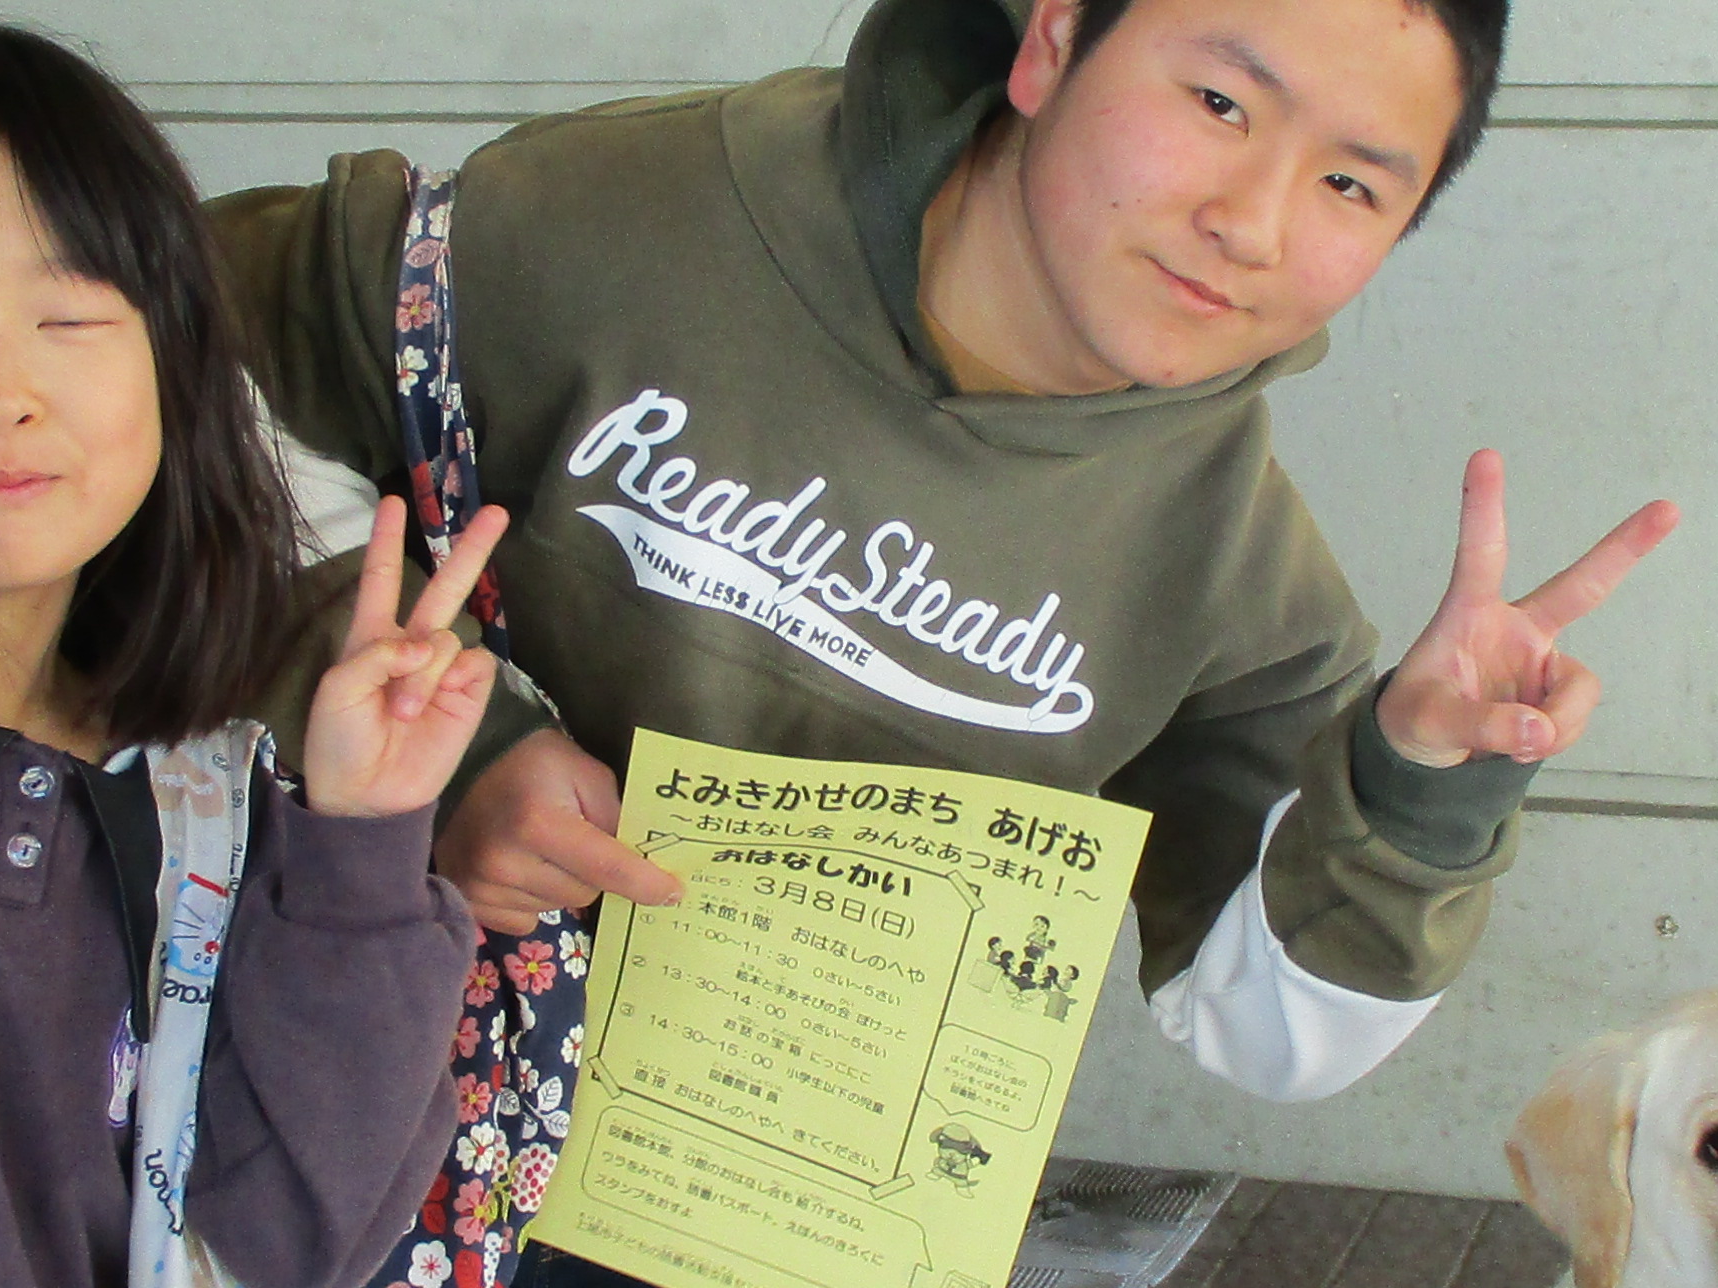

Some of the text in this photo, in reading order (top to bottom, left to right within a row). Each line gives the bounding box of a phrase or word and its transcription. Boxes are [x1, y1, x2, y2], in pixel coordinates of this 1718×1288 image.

[567, 389, 1095, 723] Ready Steady
[632, 532, 874, 668] THINK LESS LIVE MORE
[654, 767, 1103, 873] よみきかせのまち あげお
[711, 846, 913, 897] おはなしかい
[752, 875, 916, 940] 3月8日(日)
[698, 901, 927, 986] 本館1階 おはなしのへや
[674, 1082, 785, 1135] おはなしのへやへ
[792, 1127, 881, 1173] きてください。
